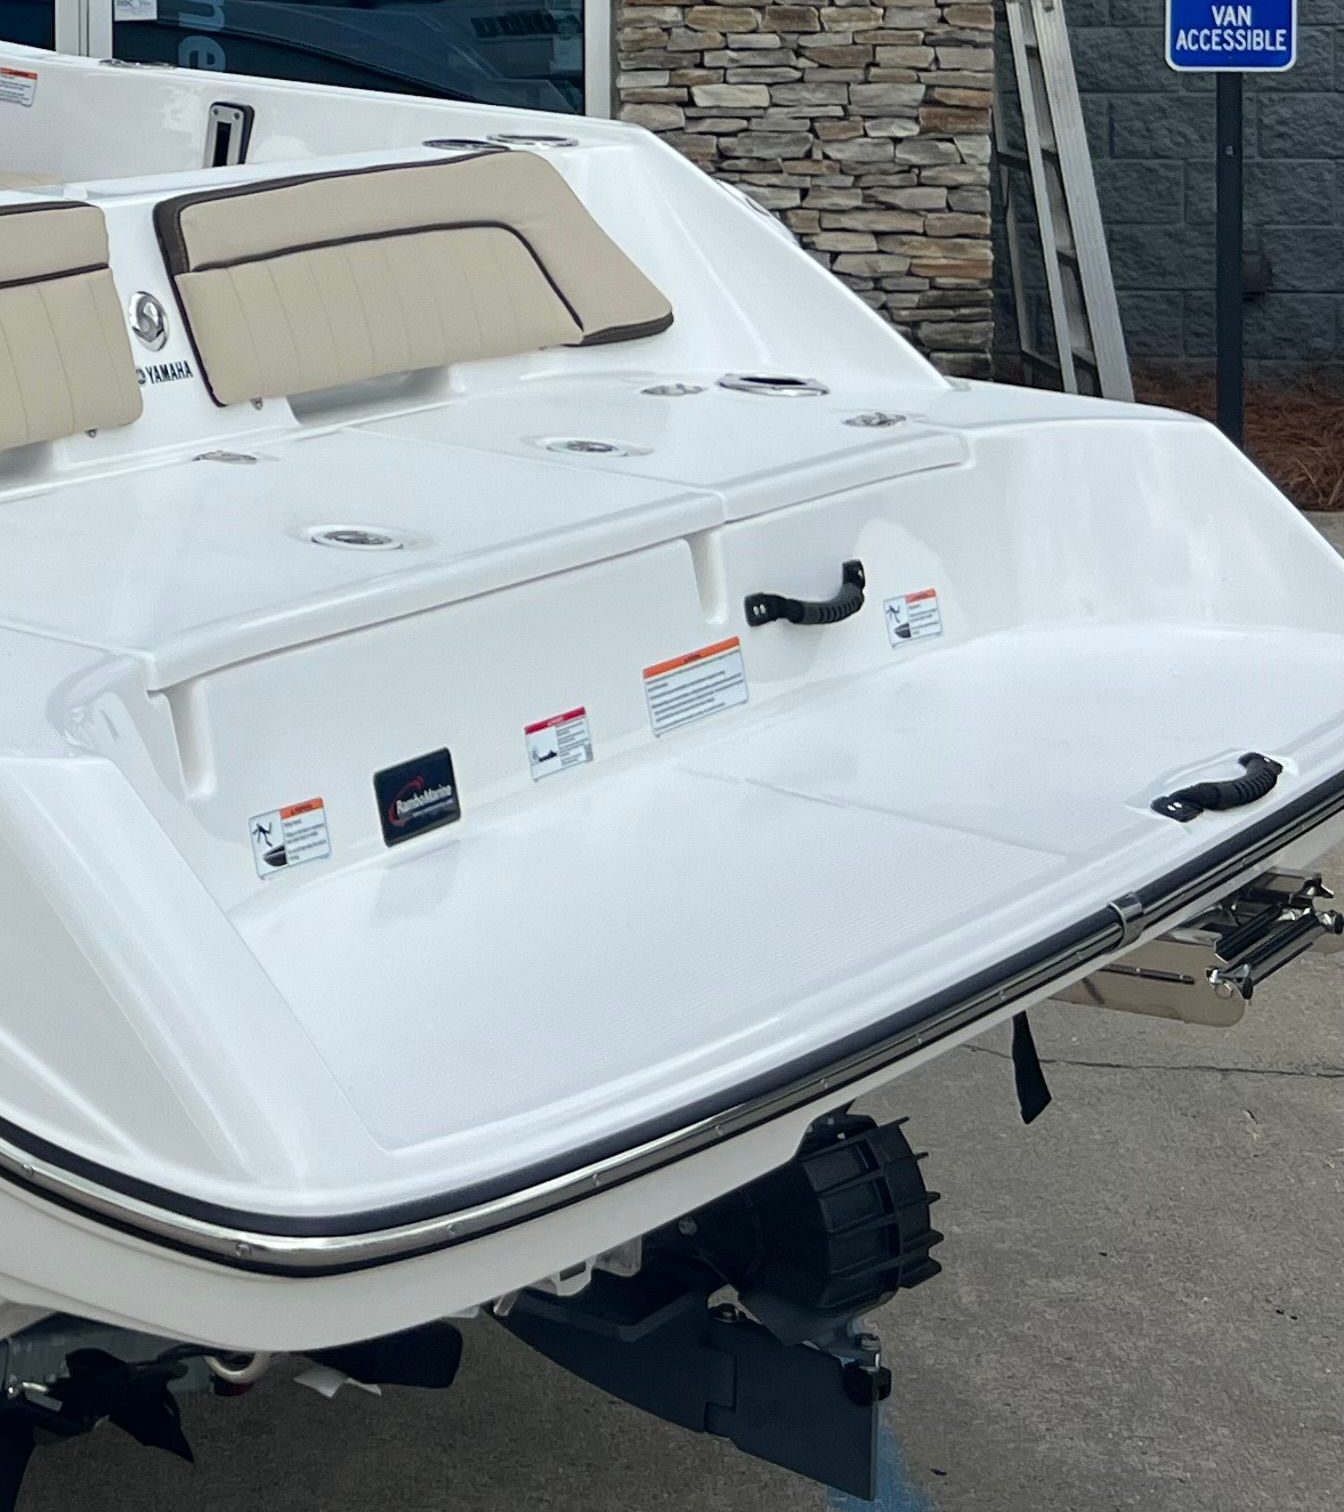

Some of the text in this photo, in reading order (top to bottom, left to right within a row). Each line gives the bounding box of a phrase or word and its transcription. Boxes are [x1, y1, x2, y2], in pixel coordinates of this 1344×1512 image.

[1211, 5, 1252, 27] VAN
[1175, 28, 1287, 52] ACCESSIBLE
[145, 360, 194, 384] YAMAHA
